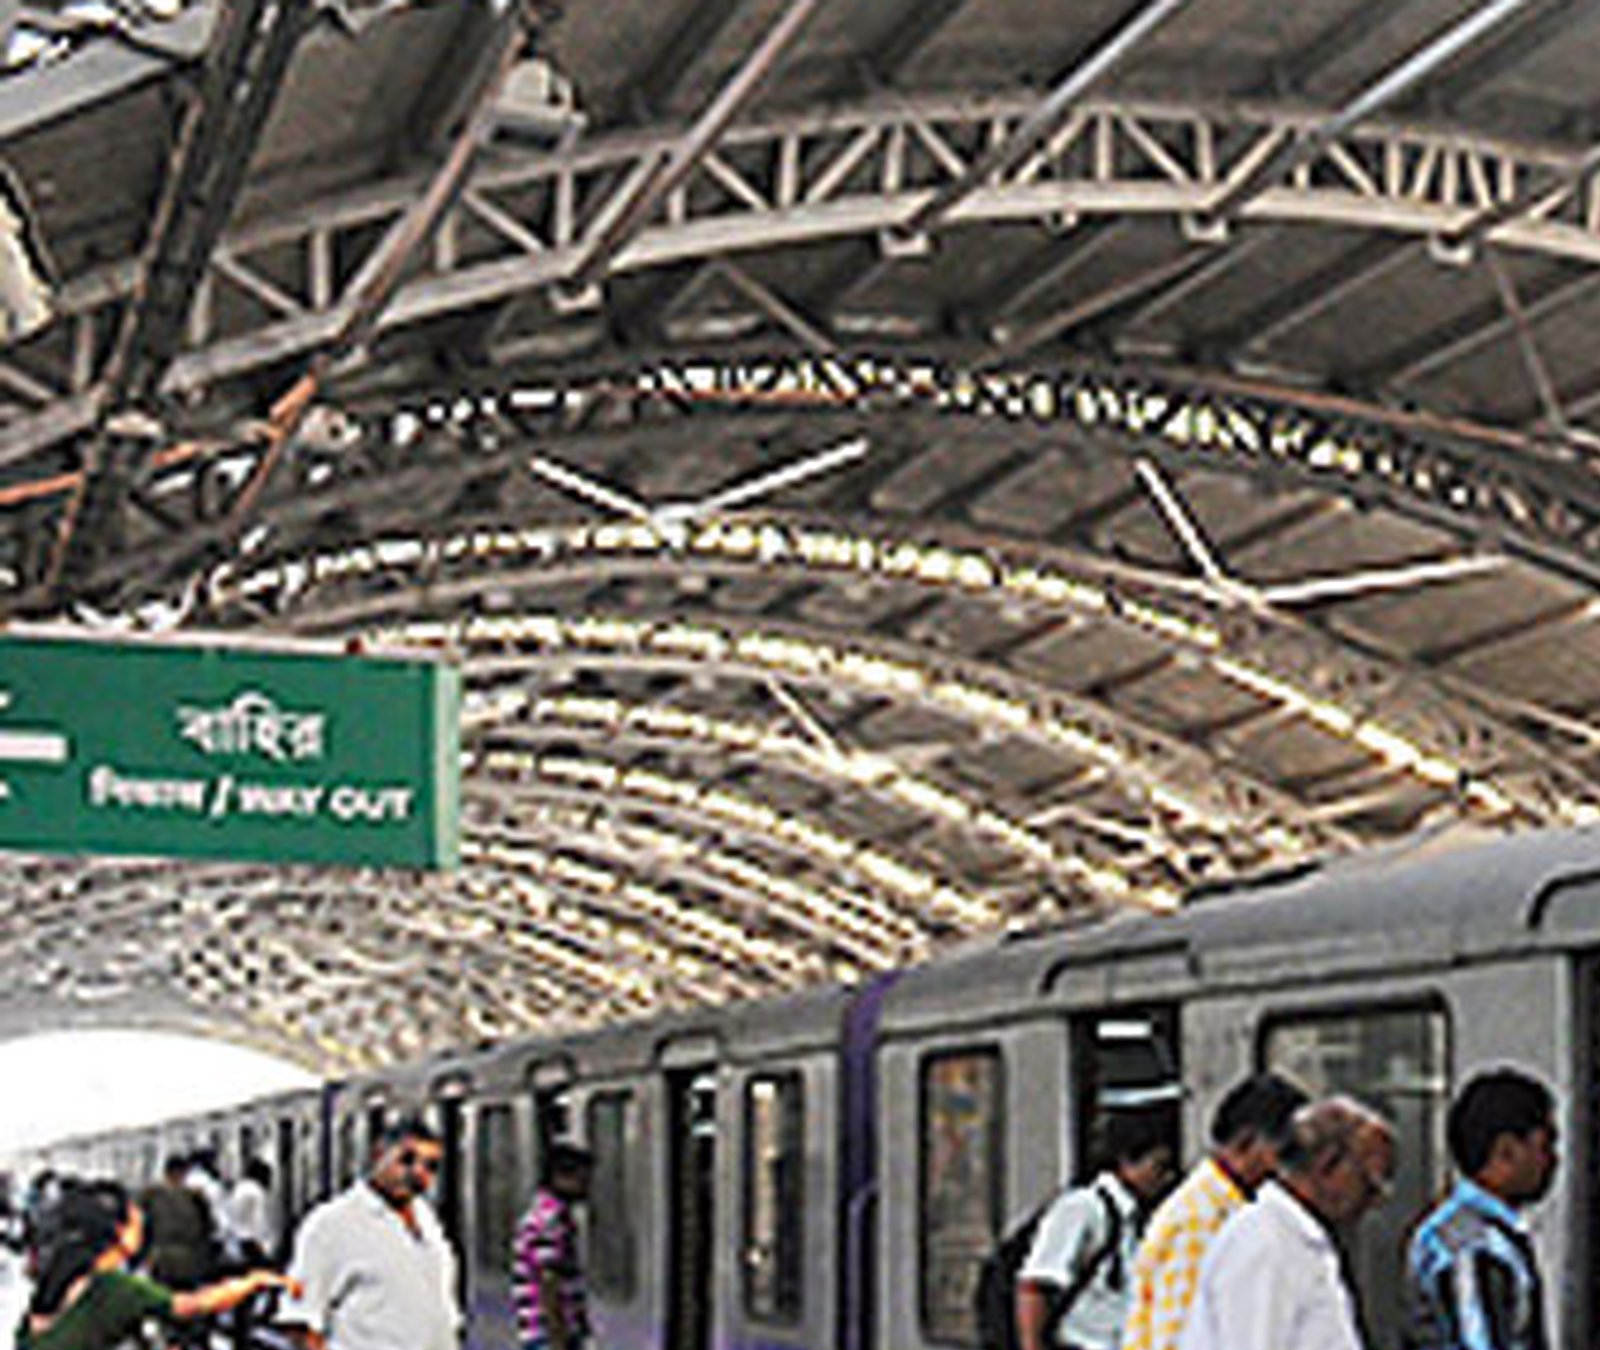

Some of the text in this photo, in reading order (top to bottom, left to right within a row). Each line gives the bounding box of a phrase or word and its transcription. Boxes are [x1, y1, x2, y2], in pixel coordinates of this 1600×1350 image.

[176, 690, 325, 760] বাহির
[239, 785, 324, 815] WAY
[330, 787, 413, 820] OUT
